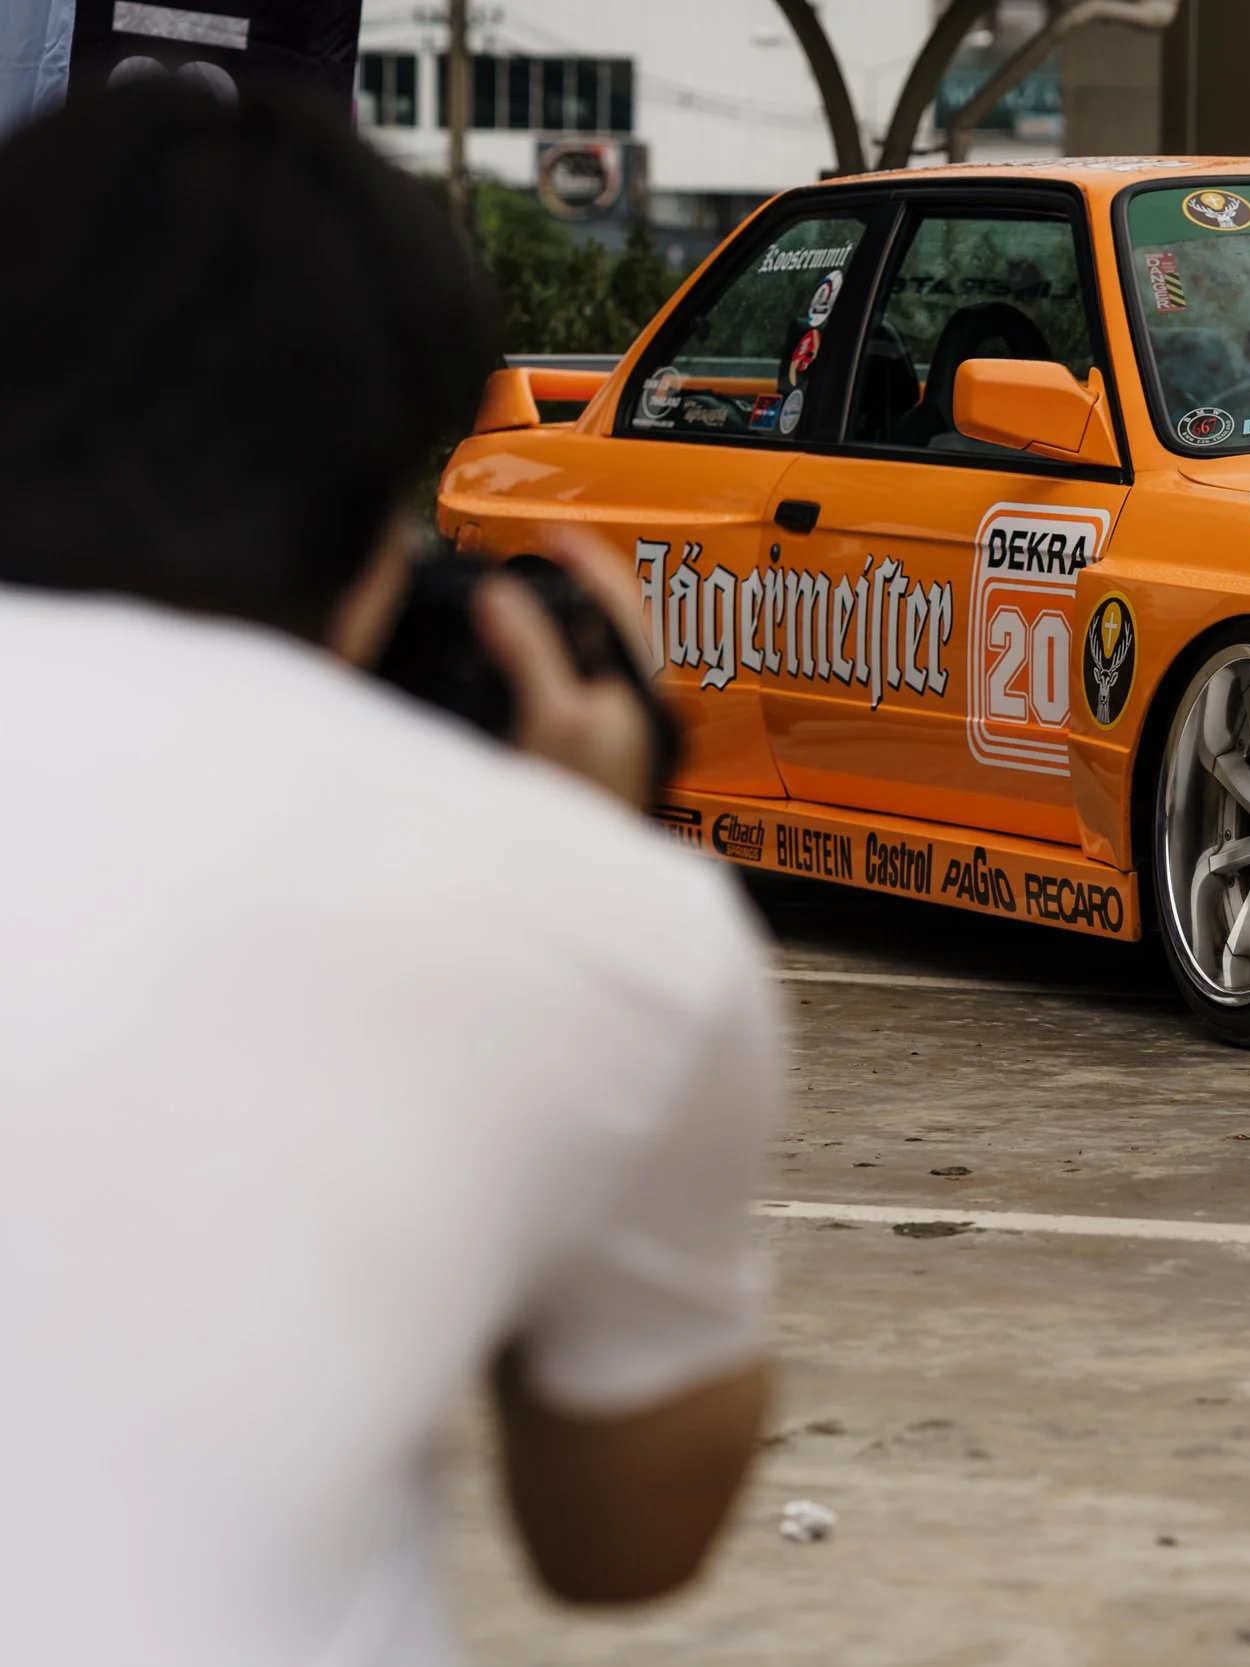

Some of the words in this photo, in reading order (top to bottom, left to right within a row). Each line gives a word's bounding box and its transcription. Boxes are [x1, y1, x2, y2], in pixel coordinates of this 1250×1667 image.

[1144, 258, 1170, 309] DANGER
[987, 528, 1088, 576] DEKRA
[986, 604, 1073, 729] 20
[711, 812, 765, 856] Eibach
[776, 823, 853, 881] BILSTEIN
[864, 831, 934, 896] Castrol
[1024, 872, 1124, 933] RECARO
